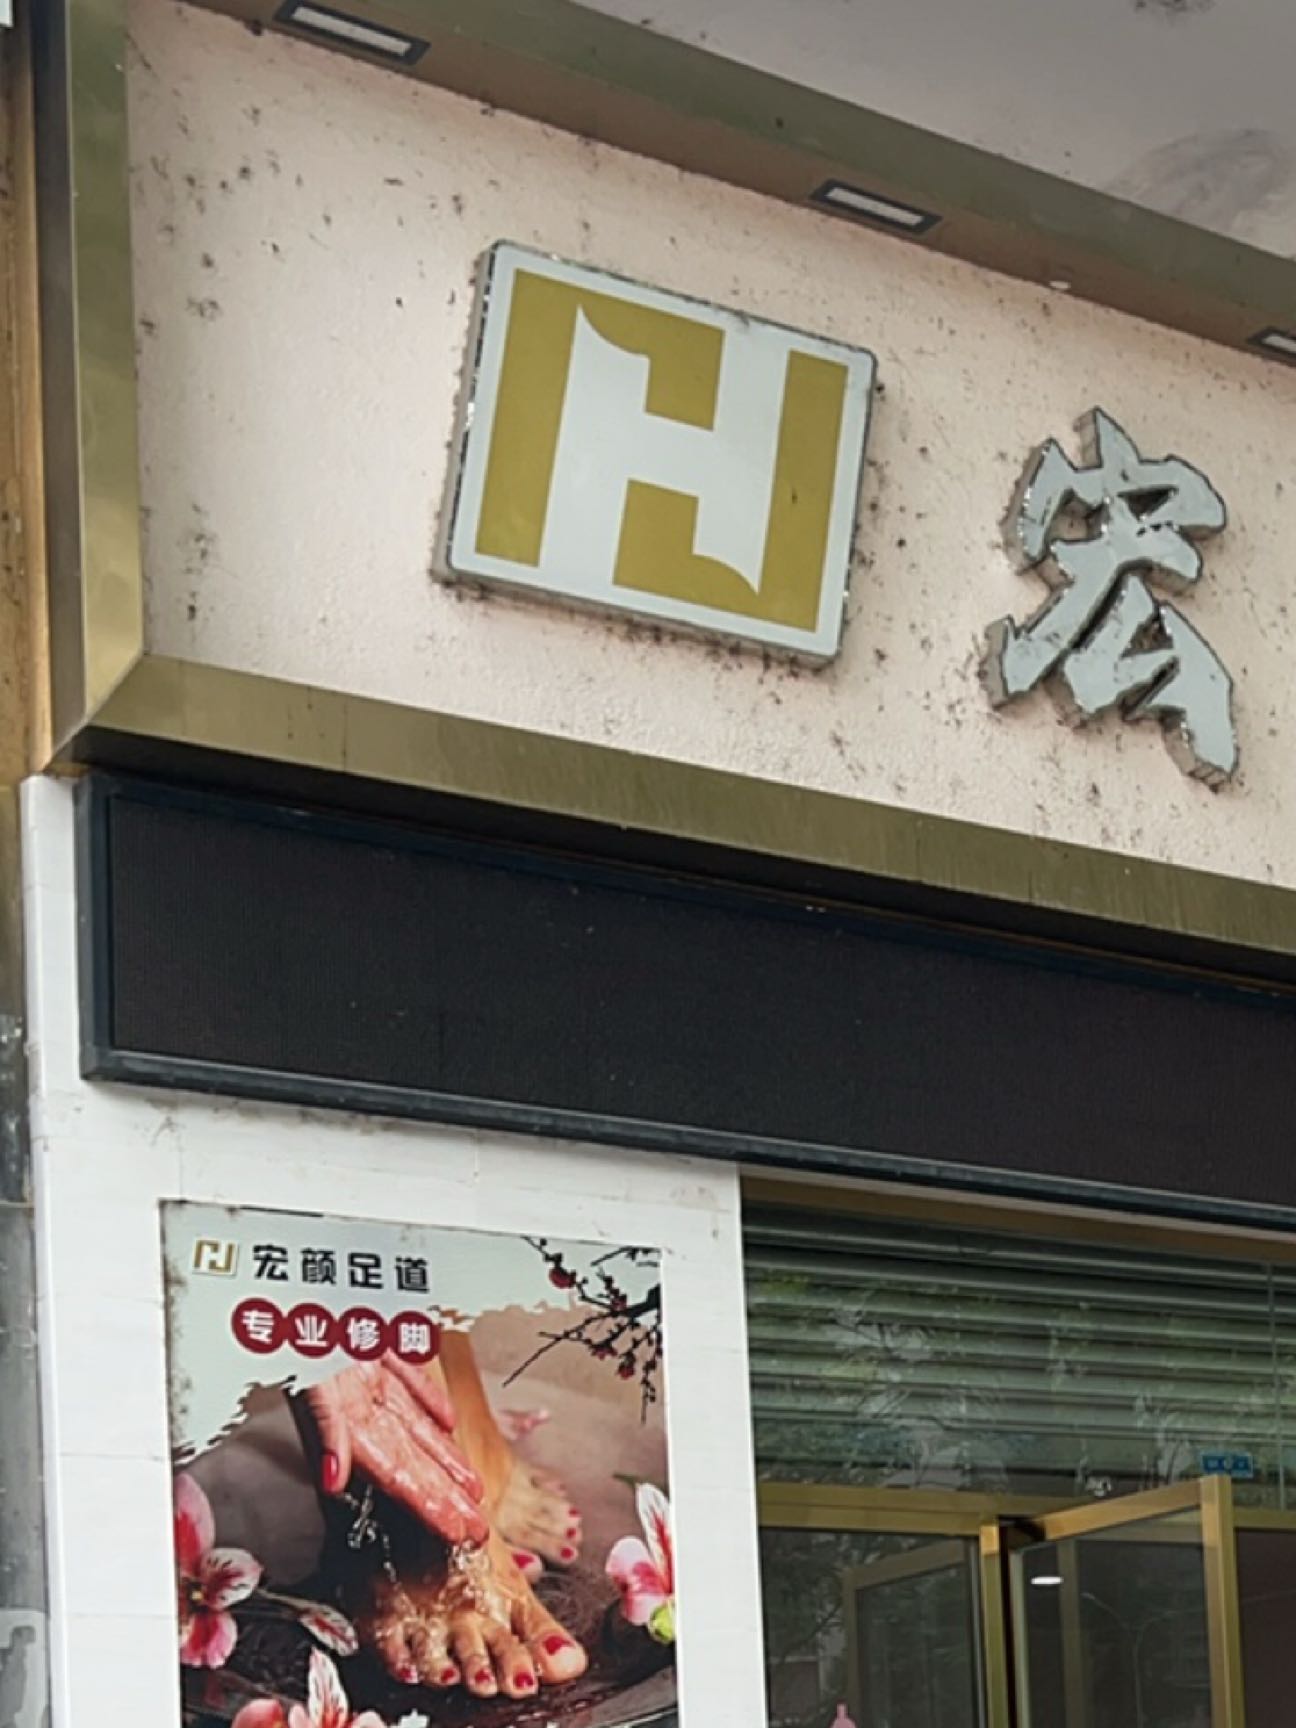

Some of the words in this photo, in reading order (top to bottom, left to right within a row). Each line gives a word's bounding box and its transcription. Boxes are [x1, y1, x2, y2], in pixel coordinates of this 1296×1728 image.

[253, 1243, 430, 1293] 宏颜足道
[242, 1308, 431, 1354] 专业修脚
